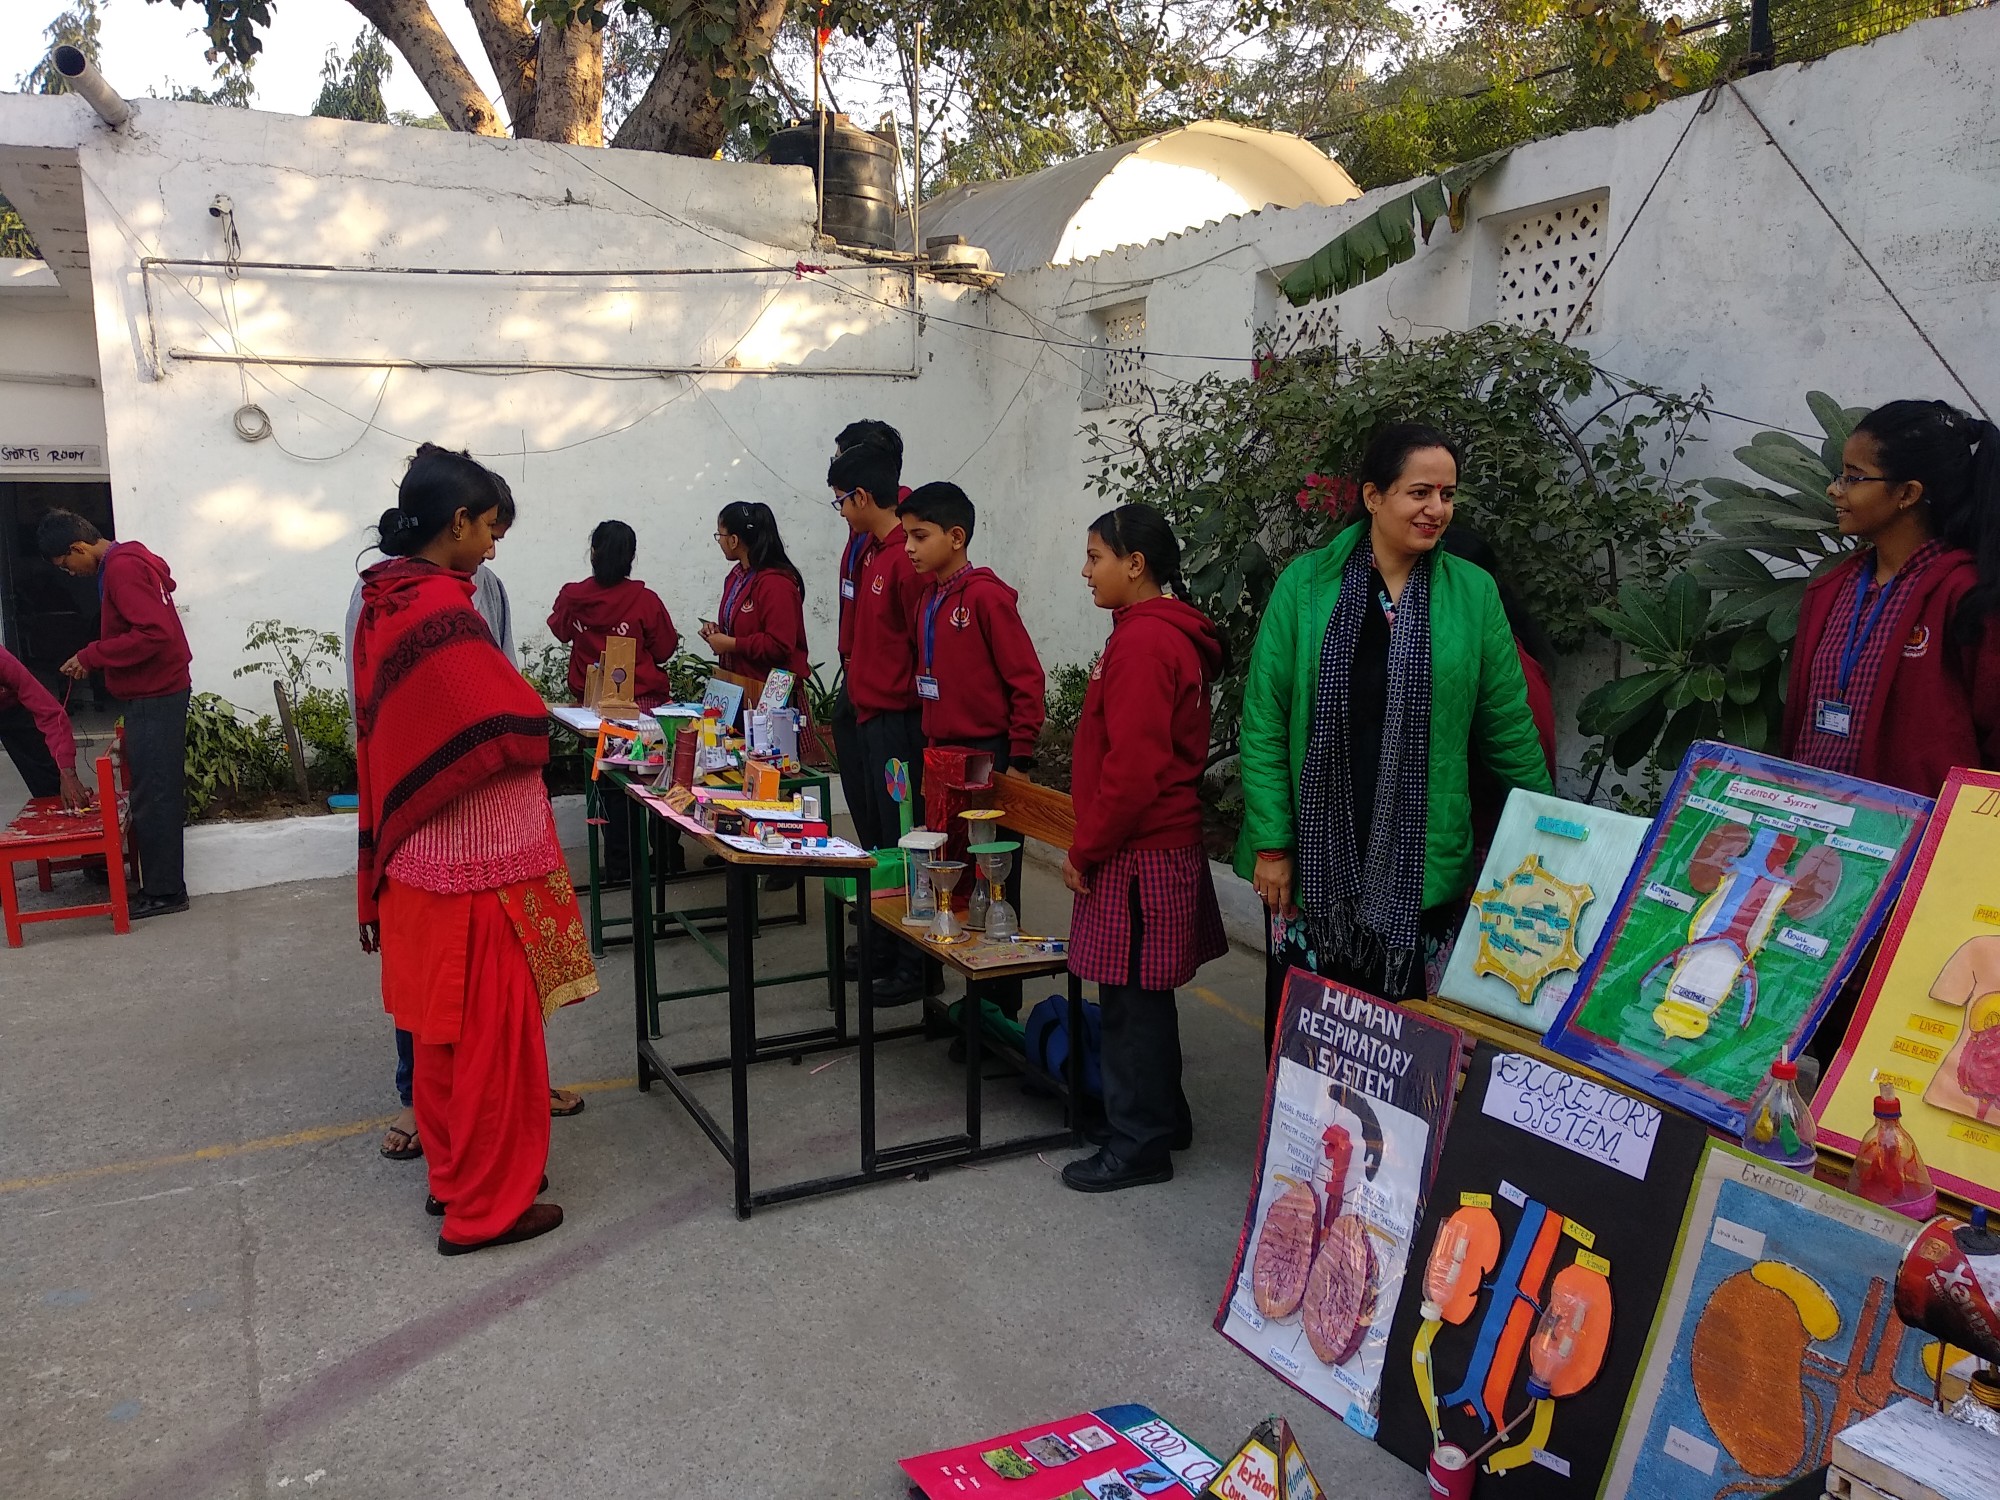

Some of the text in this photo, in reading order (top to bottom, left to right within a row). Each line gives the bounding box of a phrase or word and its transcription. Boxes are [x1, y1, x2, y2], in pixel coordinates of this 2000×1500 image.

[1, 447, 86, 462] SPORTS ROOM
[1783, 794, 1818, 810] SYSTEM
[776, 822, 804, 830] DELICIOUS
[1830, 836, 1852, 848] RIGHT
[1783, 929, 1808, 943] RENAL
[1322, 986, 1403, 1041] HUMAN
[1919, 1020, 1945, 1034] LIVER
[1297, 1006, 1414, 1077] RESPIRATORY
[1893, 1041, 1940, 1061] GALL BLADDER
[1317, 1047, 1395, 1102] SYSTEM
[1496, 1052, 1662, 1138] EXCRETORY
[1513, 1091, 1621, 1163] SYSTEM
[1962, 1129, 1990, 1144] ANUS
[1870, 1218, 1895, 1235] IN
[1128, 1420, 1187, 1457] FOOD
[1237, 1452, 1278, 1500] Tertiary
